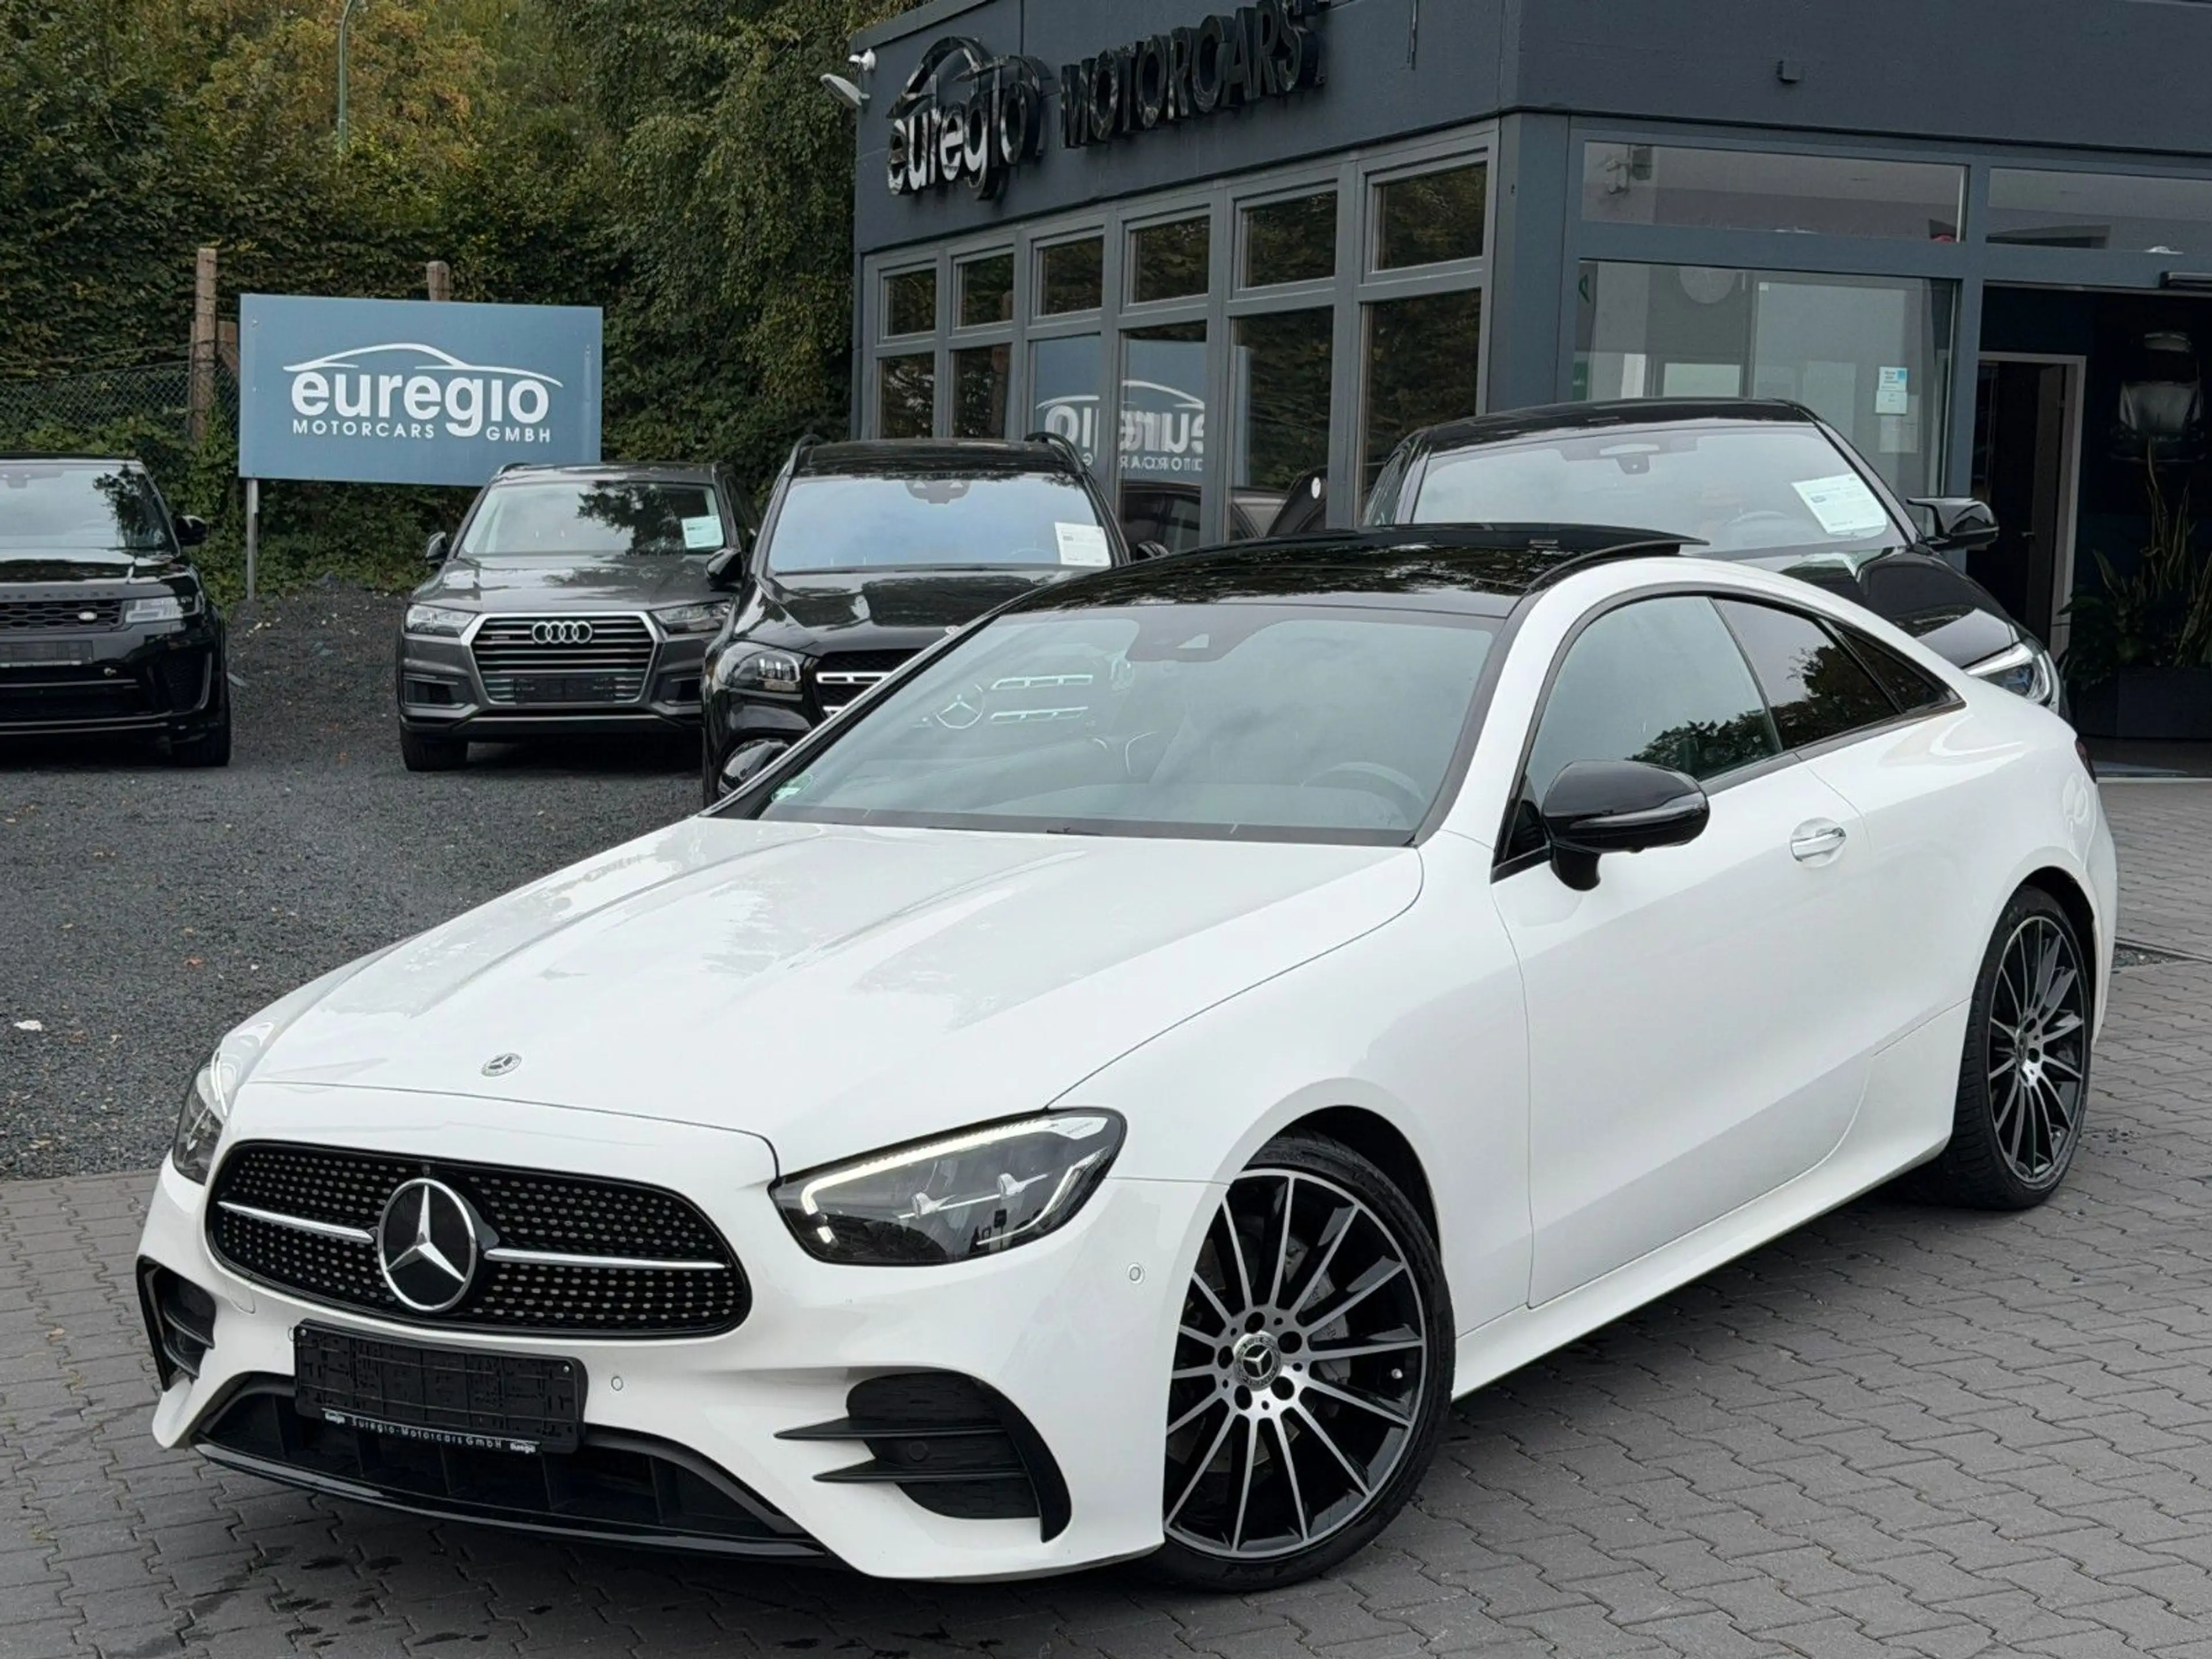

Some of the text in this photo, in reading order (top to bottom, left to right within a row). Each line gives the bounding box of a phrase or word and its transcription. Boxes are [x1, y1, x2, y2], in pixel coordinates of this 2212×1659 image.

[888, 0, 1306, 200] euregio MOTORCARS
[291, 372, 550, 438] euregio
[293, 419, 551, 443] MOTORCARS GMBH
